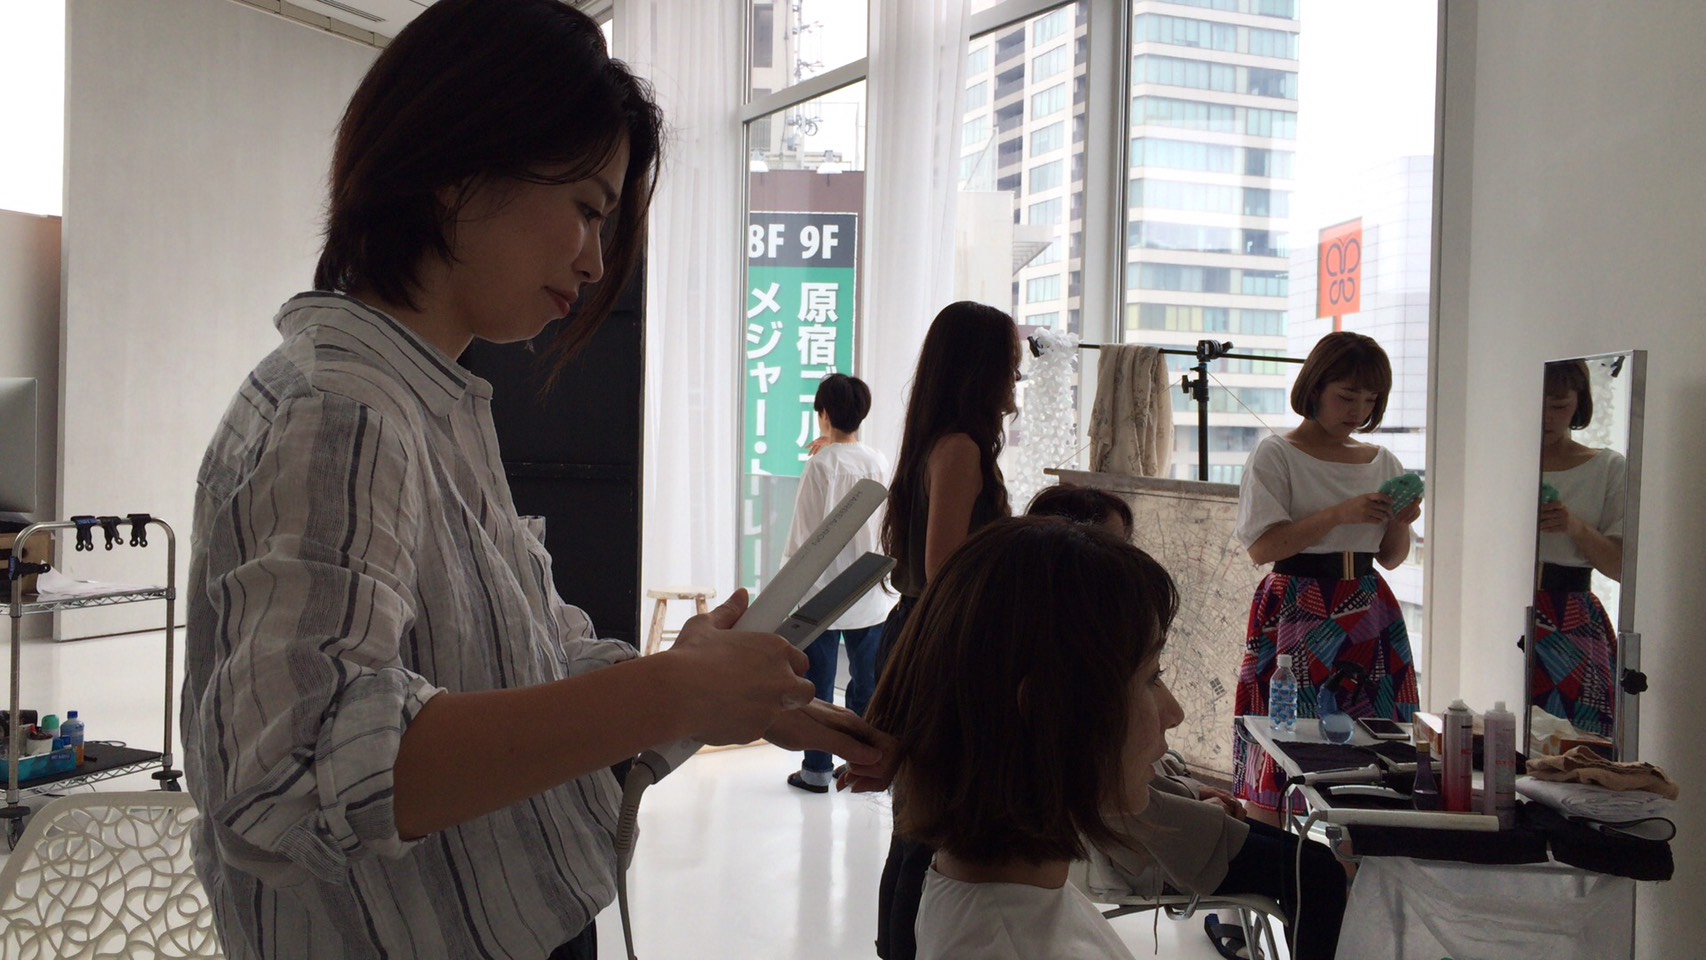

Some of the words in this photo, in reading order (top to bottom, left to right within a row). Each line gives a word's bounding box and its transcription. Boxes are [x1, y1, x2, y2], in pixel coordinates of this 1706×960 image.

[749, 223, 785, 259] 8F
[800, 224, 839, 259] 9F
[796, 282, 839, 462] 原宿ゴル
